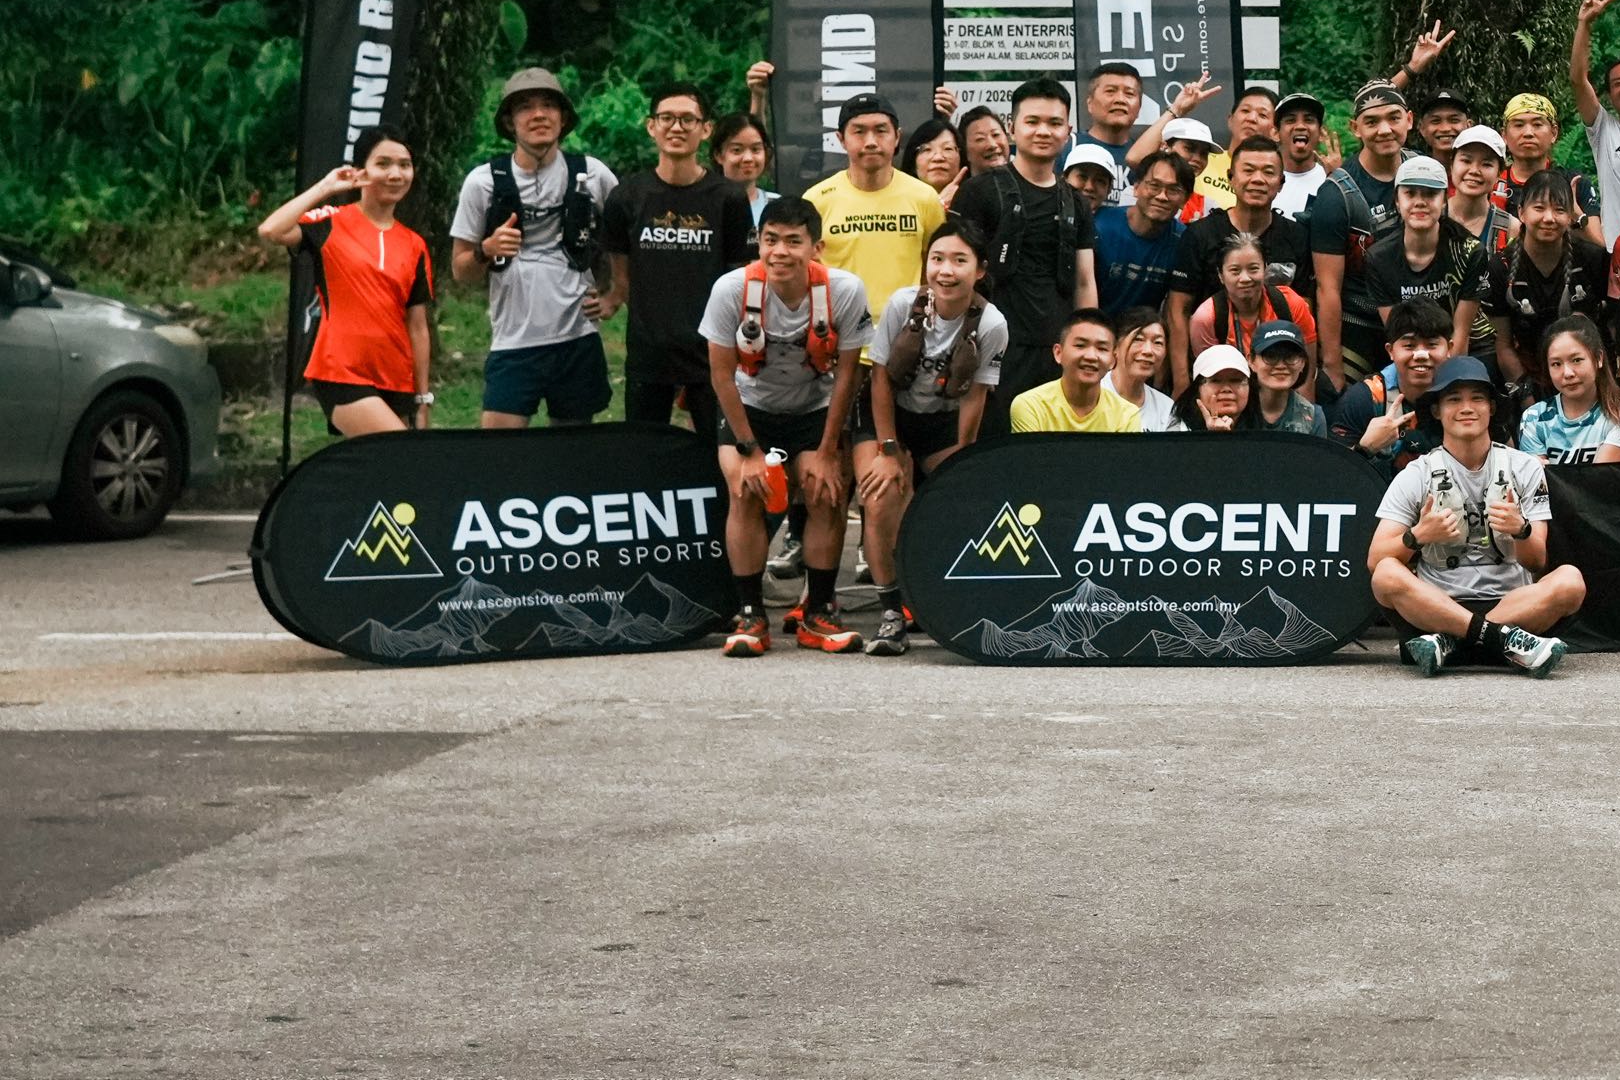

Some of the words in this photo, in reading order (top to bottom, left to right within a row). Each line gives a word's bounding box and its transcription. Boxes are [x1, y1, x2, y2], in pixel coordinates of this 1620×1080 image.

[959, 25, 1003, 36] DREAM
[962, 52, 985, 60] SHAH
[1015, 52, 1060, 60] SELANGOR
[962, 90, 975, 102] 07
[846, 215, 897, 223] MOUNTAIN
[640, 227, 714, 245] ASCENT
[829, 222, 897, 235] GUNUNG
[451, 487, 718, 551] ASCENT
[1072, 503, 1357, 553] ASCENT
[456, 550, 601, 576] OUTDOOR
[618, 541, 723, 566] SPORTS
[1074, 558, 1221, 578] OUTDOOR
[1239, 558, 1352, 578] SPORTS
[438, 589, 625, 612] www.ascentstore.com.my
[1051, 599, 1241, 616] www.ascentstore.com.my
